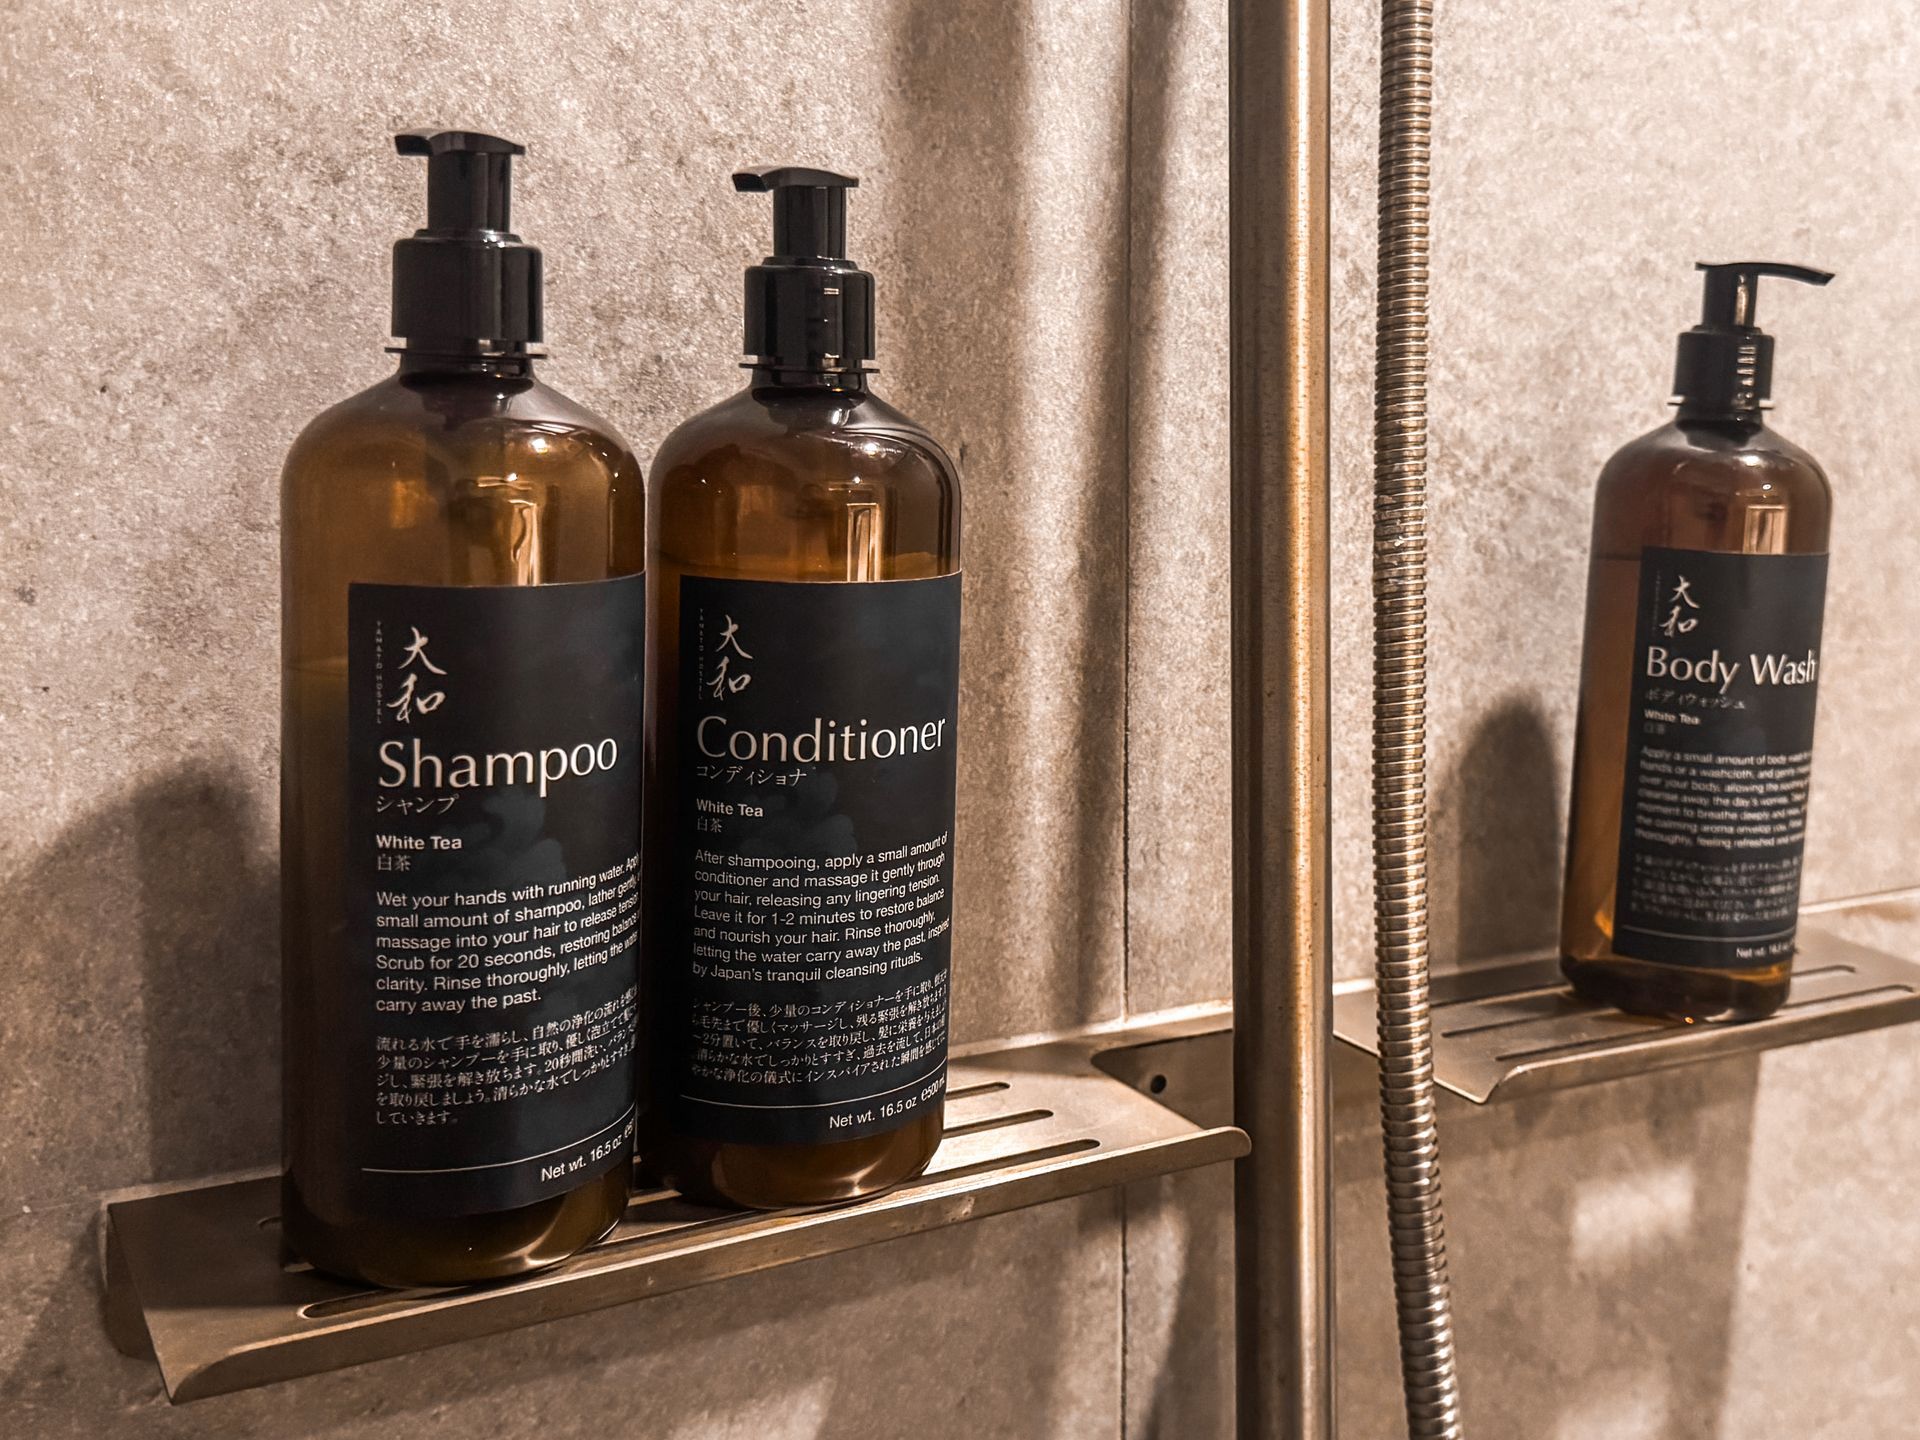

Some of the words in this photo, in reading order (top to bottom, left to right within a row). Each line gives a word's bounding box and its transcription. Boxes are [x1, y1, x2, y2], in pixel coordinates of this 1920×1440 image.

[1645, 645, 1740, 695] Body
[1750, 649, 1818, 686] Wash
[1644, 709, 1677, 722] White
[1679, 713, 1700, 725] Tea
[697, 715, 946, 763] Conditioner
[378, 738, 618, 798] Shampoo
[1683, 753, 1712, 763] small
[1716, 755, 1754, 766] amount
[696, 798, 734, 815] White
[738, 803, 764, 818] Tea
[1697, 809, 1738, 820] breathe
[376, 834, 424, 850] White
[430, 835, 462, 850] Tea
[695, 849, 724, 865] After
[727, 853, 820, 873] shampooing,
[824, 852, 863, 870] apply
[866, 854, 875, 864] a
[878, 845, 908, 863] small
[910, 836, 940, 856] amount
[941, 830, 948, 845] of
[377, 853, 411, 871] 白茶
[694, 869, 768, 887] conditioner
[772, 874, 800, 888] and
[804, 872, 868, 888] massage
[871, 869, 879, 882] it
[882, 863, 915, 883] gently
[917, 851, 946, 872] through
[376, 891, 408, 907] Wet
[412, 894, 450, 910] your
[454, 889, 507, 906] hands
[512, 885, 545, 902] with
[548, 874, 597, 896] running
[599, 864, 625, 883] water.
[694, 888, 722, 903] your
[756, 893, 821, 909] releasing
[826, 893, 851, 907] any
[855, 884, 906, 904] lingering
[908, 874, 940, 893] tension.
[376, 913, 419, 928] small
[423, 910, 489, 929] amount
[493, 909, 510, 925] of
[515, 899, 585, 923] shampoo,
[588, 887, 616, 906] lather
[694, 905, 730, 922] Leave
[735, 909, 743, 923] it
[747, 911, 767, 925] for
[771, 912, 795, 926] 1-2
[799, 910, 856, 926] minutes
[860, 909, 873, 921] to
[876, 900, 914, 918] restore
[916, 888, 945, 909] balance
[376, 935, 451, 952] massage
[456, 932, 488, 948] into
[493, 930, 528, 949] your
[533, 922, 560, 941] hair
[564, 920, 577, 933] to
[580, 906, 617, 929] release
[694, 925, 716, 940] and
[719, 930, 770, 944] nourish
[774, 932, 806, 947] your
[811, 929, 840, 944] hair.
[845, 926, 882, 941] Rinse
[884, 910, 936, 935] thoroughly,
[376, 955, 424, 971] Scrub
[430, 955, 453, 970] for
[458, 954, 479, 969] 20
[484, 947, 556, 967] seconds,
[560, 929, 610, 954] restoring
[376, 977, 427, 994] clarity.
[433, 976, 481, 991] Rinse
[487, 961, 571, 987] thoroughly,
[573, 950, 608, 972] letting
[610, 942, 623, 957] the
[692, 962, 708, 977] by
[711, 967, 763, 982] Japan's
[767, 968, 821, 984] tranquil
[825, 960, 888, 980] cleansing
[890, 951, 923, 970] rituals.
[693, 942, 731, 963] letting
[735, 948, 757, 962] the
[761, 951, 802, 964] water
[805, 950, 841, 964] carry
[845, 944, 880, 959] away
[883, 939, 901, 953] the
[376, 1000, 416, 1015] carry
[422, 1000, 465, 1014] away
[472, 993, 497, 1009] the
[502, 990, 542, 1009] past.
[829, 1114, 853, 1129] Net
[856, 1109, 875, 1124] wt.
[880, 1100, 903, 1118] 16.5
[905, 1096, 917, 1110] oz
[541, 1163, 565, 1182] Net
[568, 1155, 587, 1172] wt.
[590, 1140, 611, 1162] 16.5
[612, 1134, 622, 1150] oz
